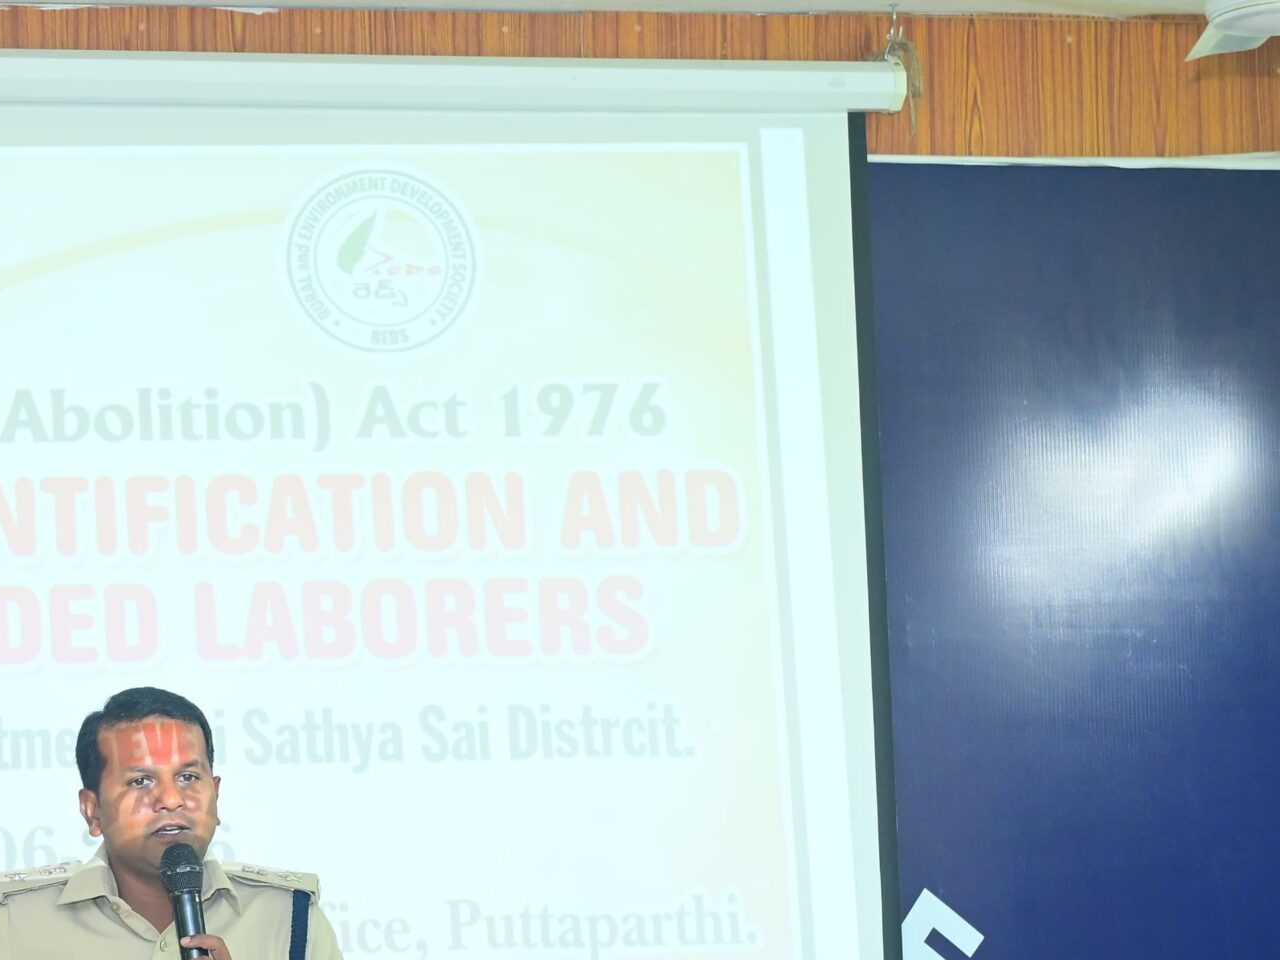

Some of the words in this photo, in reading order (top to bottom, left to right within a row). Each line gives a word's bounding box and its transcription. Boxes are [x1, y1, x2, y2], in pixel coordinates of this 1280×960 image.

[297, 176, 389, 241] ENVIRONMENT
[389, 178, 468, 261] DEVELOPMENT
[294, 243, 311, 272] and
[297, 274, 332, 322] RURAL
[435, 262, 468, 322] SOCIETY
[356, 385, 468, 440] Act
[502, 381, 668, 438] 1976
[559, 467, 741, 551] AND
[193, 574, 649, 664] LABORERS
[241, 706, 405, 774] Sathya
[418, 703, 492, 764] Sai
[506, 700, 697, 763] Distrcit.
